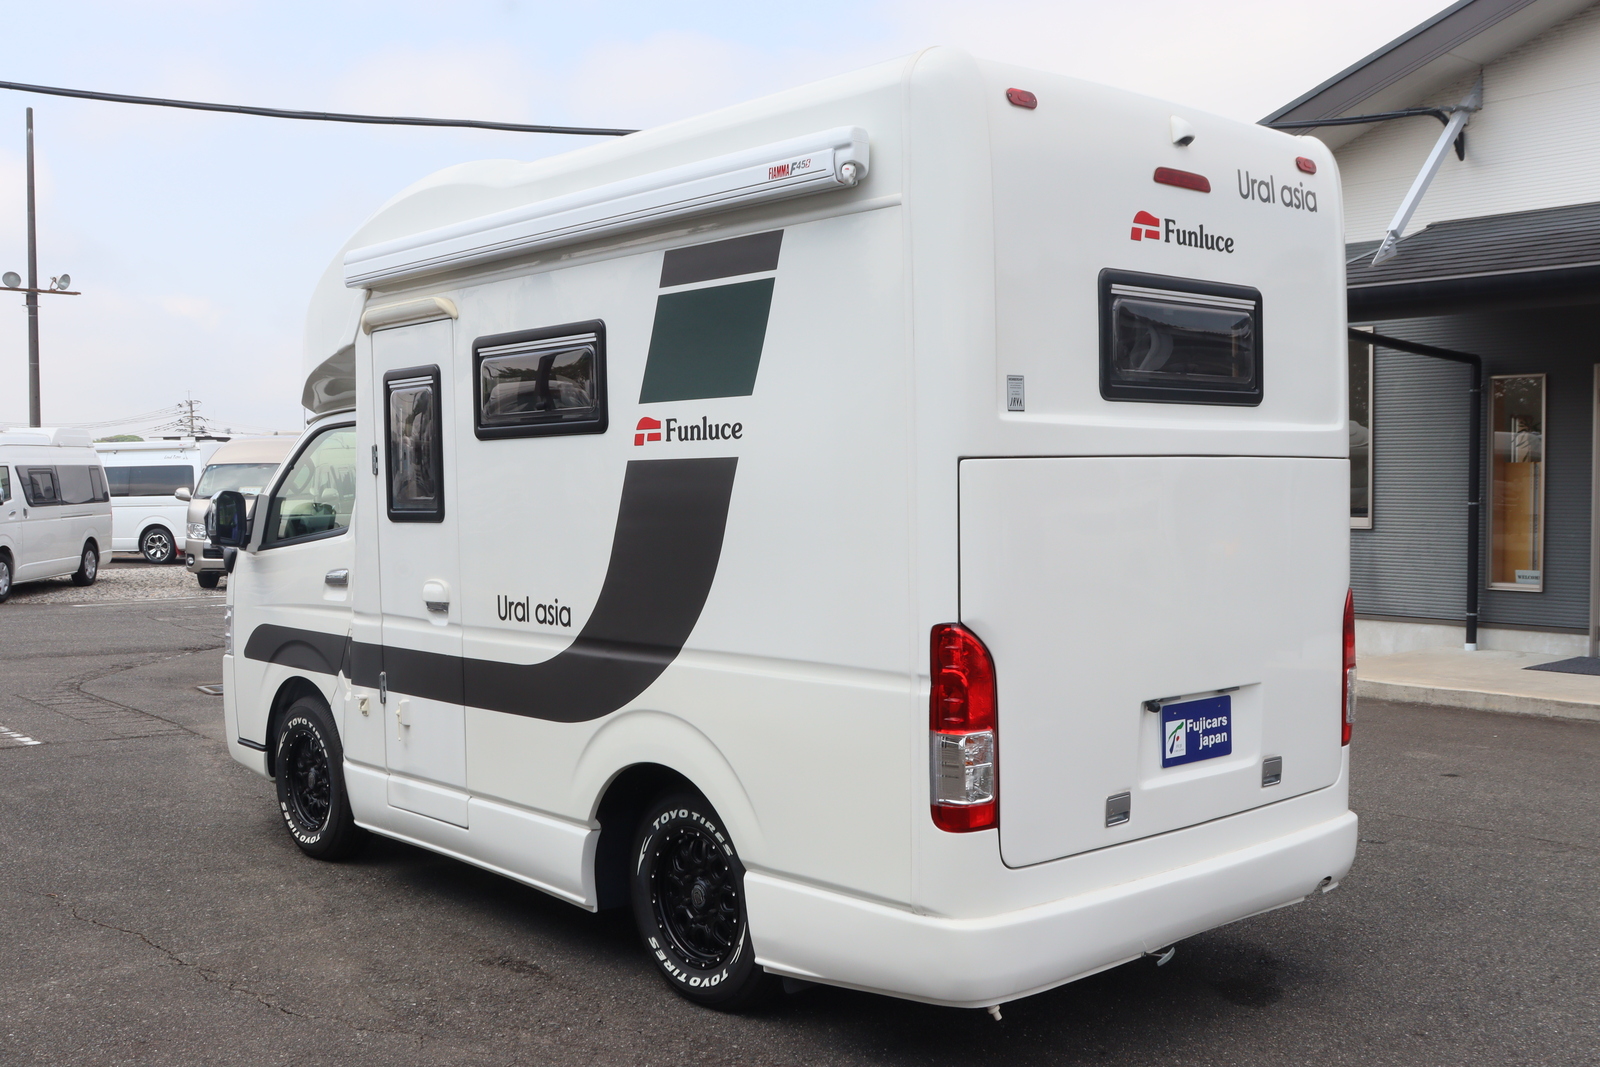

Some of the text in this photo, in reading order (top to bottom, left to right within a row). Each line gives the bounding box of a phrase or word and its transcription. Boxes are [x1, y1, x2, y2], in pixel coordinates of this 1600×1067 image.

[768, 163, 790, 180] FIAMMA
[1237, 168, 1318, 213] Ural asia
[1164, 218, 1235, 254] Funluce
[665, 415, 743, 442] Funluce
[497, 594, 571, 628] Ural asia
[288, 717, 307, 729] TOYO
[1186, 716, 1228, 734] Fujicars
[1199, 732, 1228, 750] japan
[281, 801, 321, 844] TOYO TIRES
[652, 809, 733, 857] TOYO TIRES
[648, 936, 729, 988] TOYO TIRES
